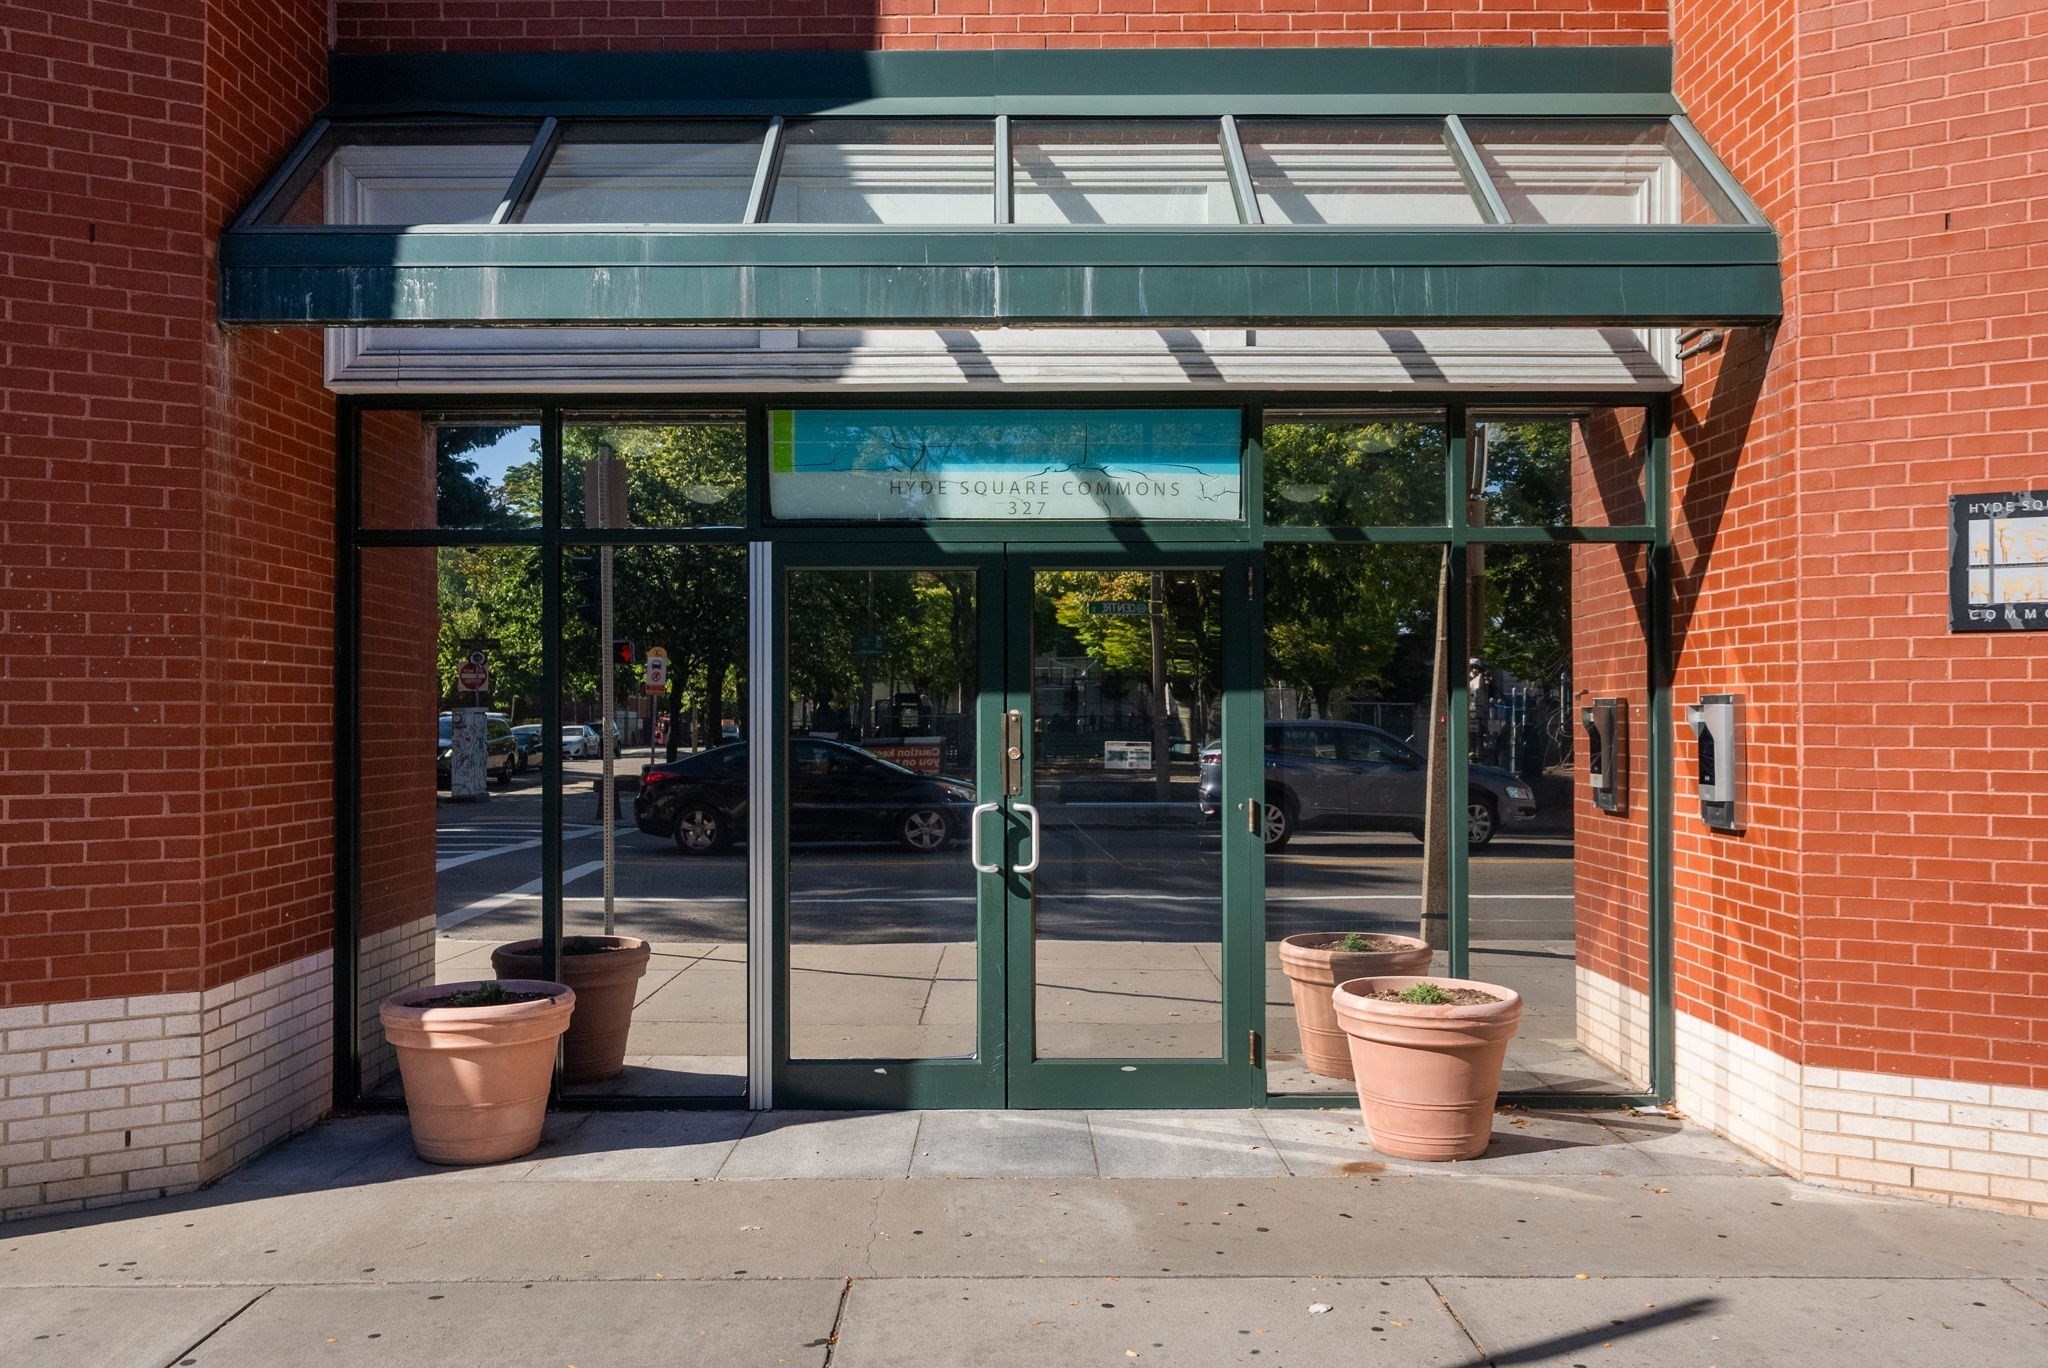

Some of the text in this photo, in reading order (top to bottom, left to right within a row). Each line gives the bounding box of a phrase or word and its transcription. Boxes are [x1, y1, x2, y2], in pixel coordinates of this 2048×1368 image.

[889, 480, 1181, 497] HYDE SQUARE COMMONS
[1008, 501, 1047, 515] 327
[1970, 500, 2048, 513] HYDE SQ
